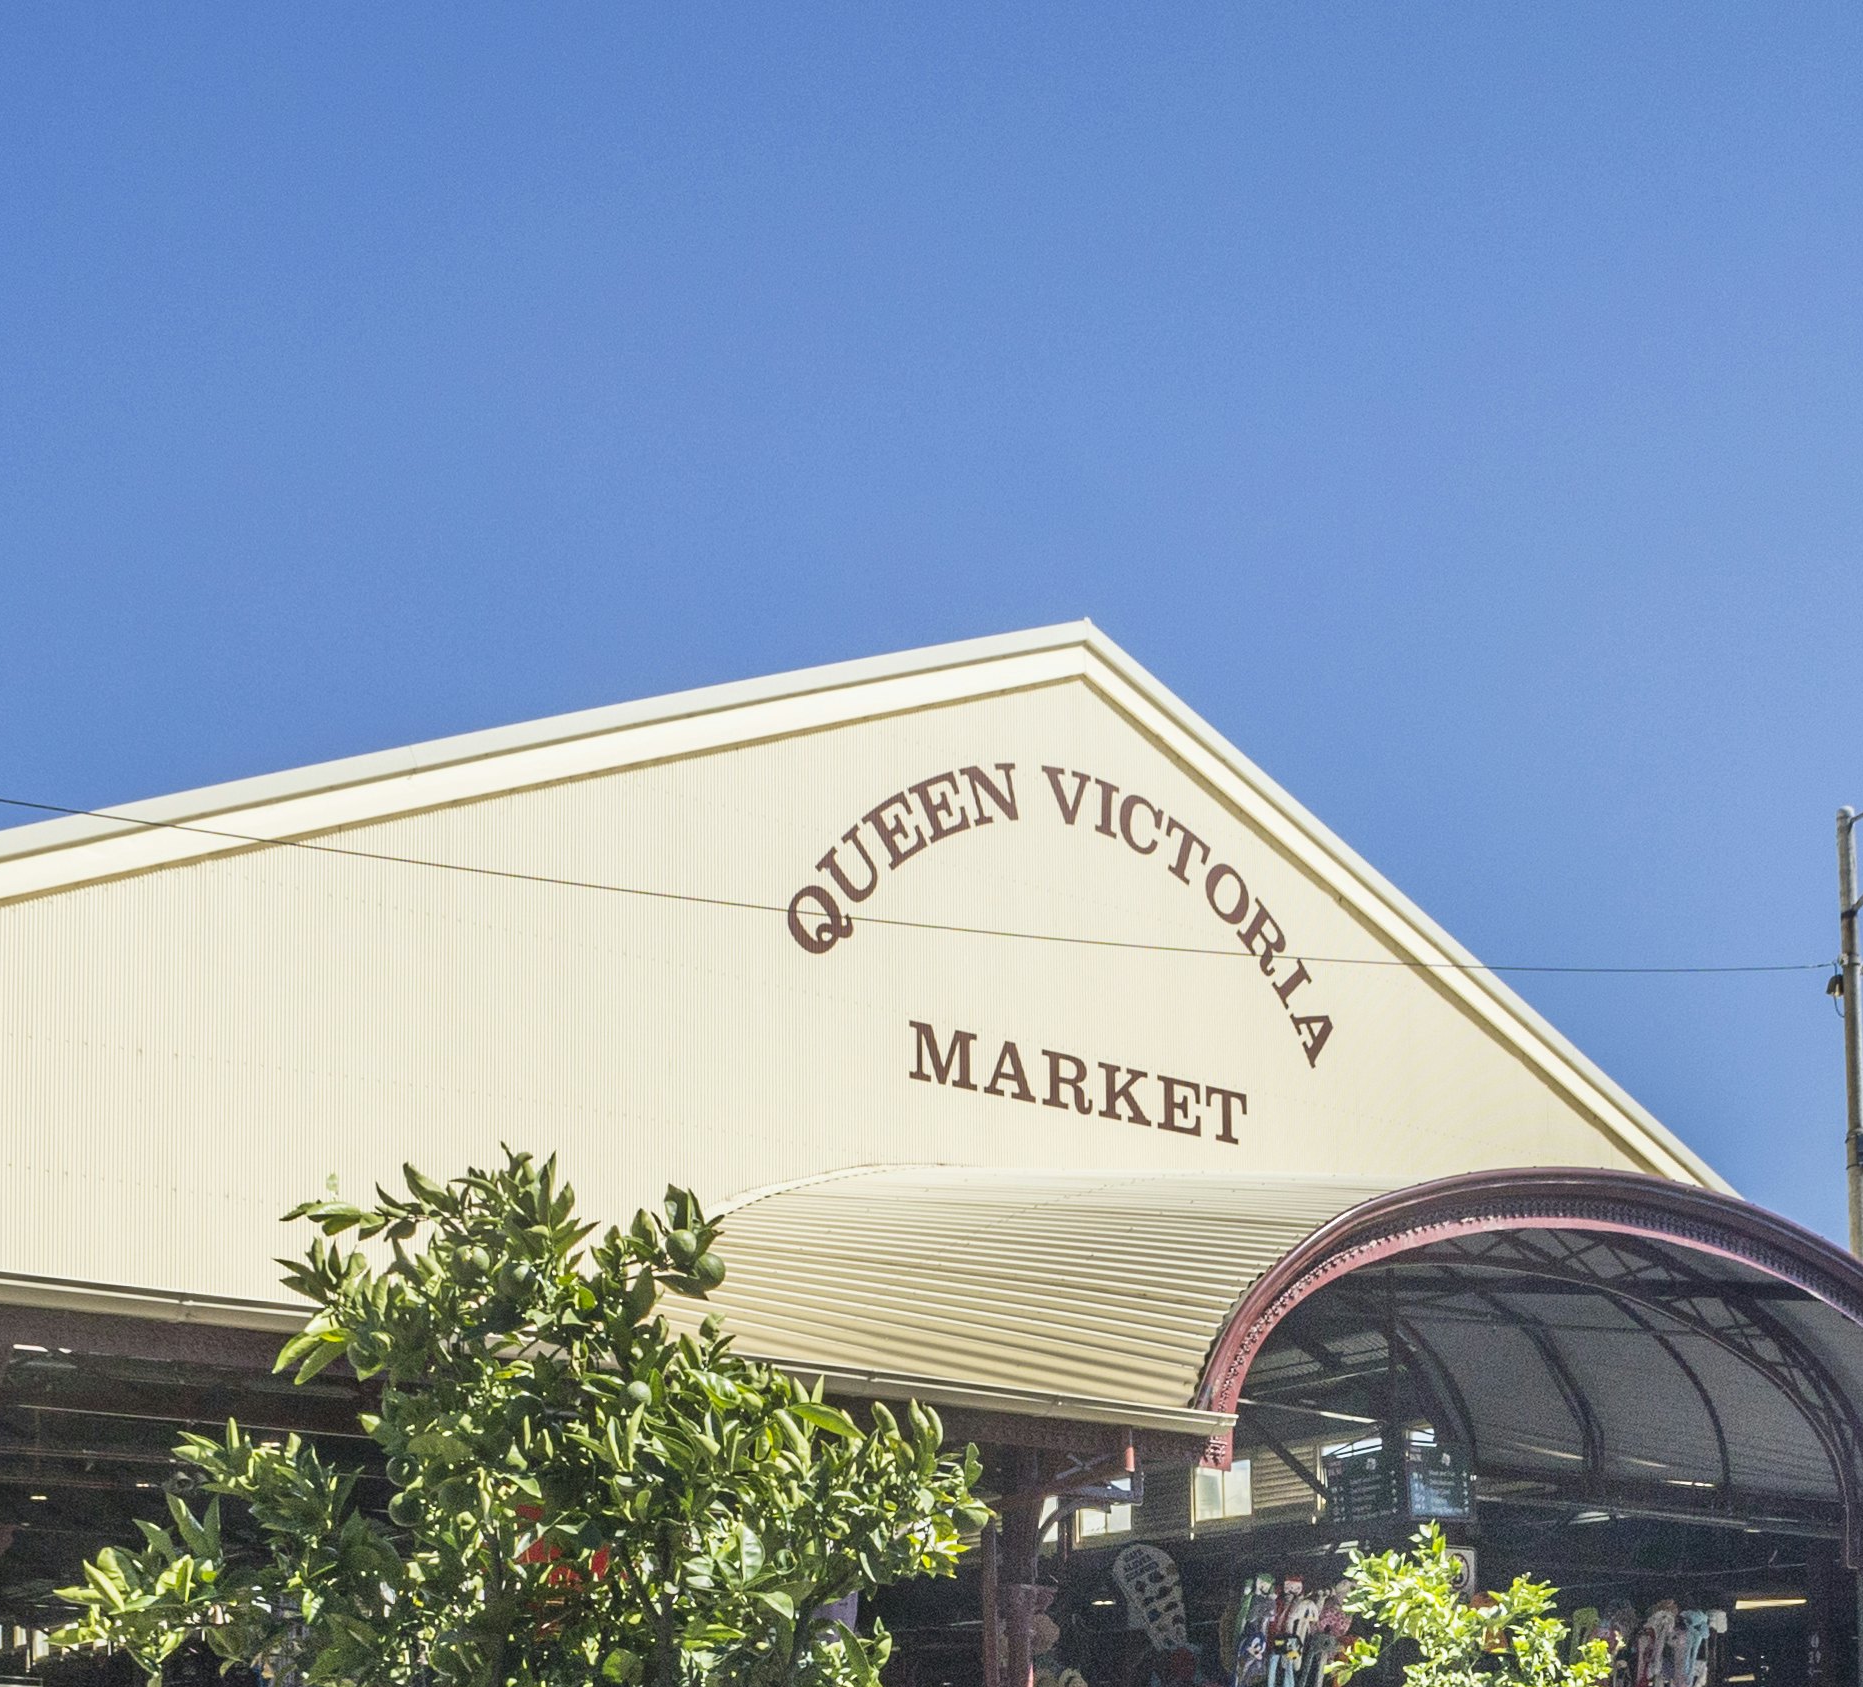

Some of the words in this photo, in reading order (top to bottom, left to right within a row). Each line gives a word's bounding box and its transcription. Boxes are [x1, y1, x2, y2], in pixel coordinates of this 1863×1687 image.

[787, 763, 1019, 955] QUEEN
[1042, 765, 1334, 1069] VICTORIA
[908, 1020, 1247, 1145] MARKET
